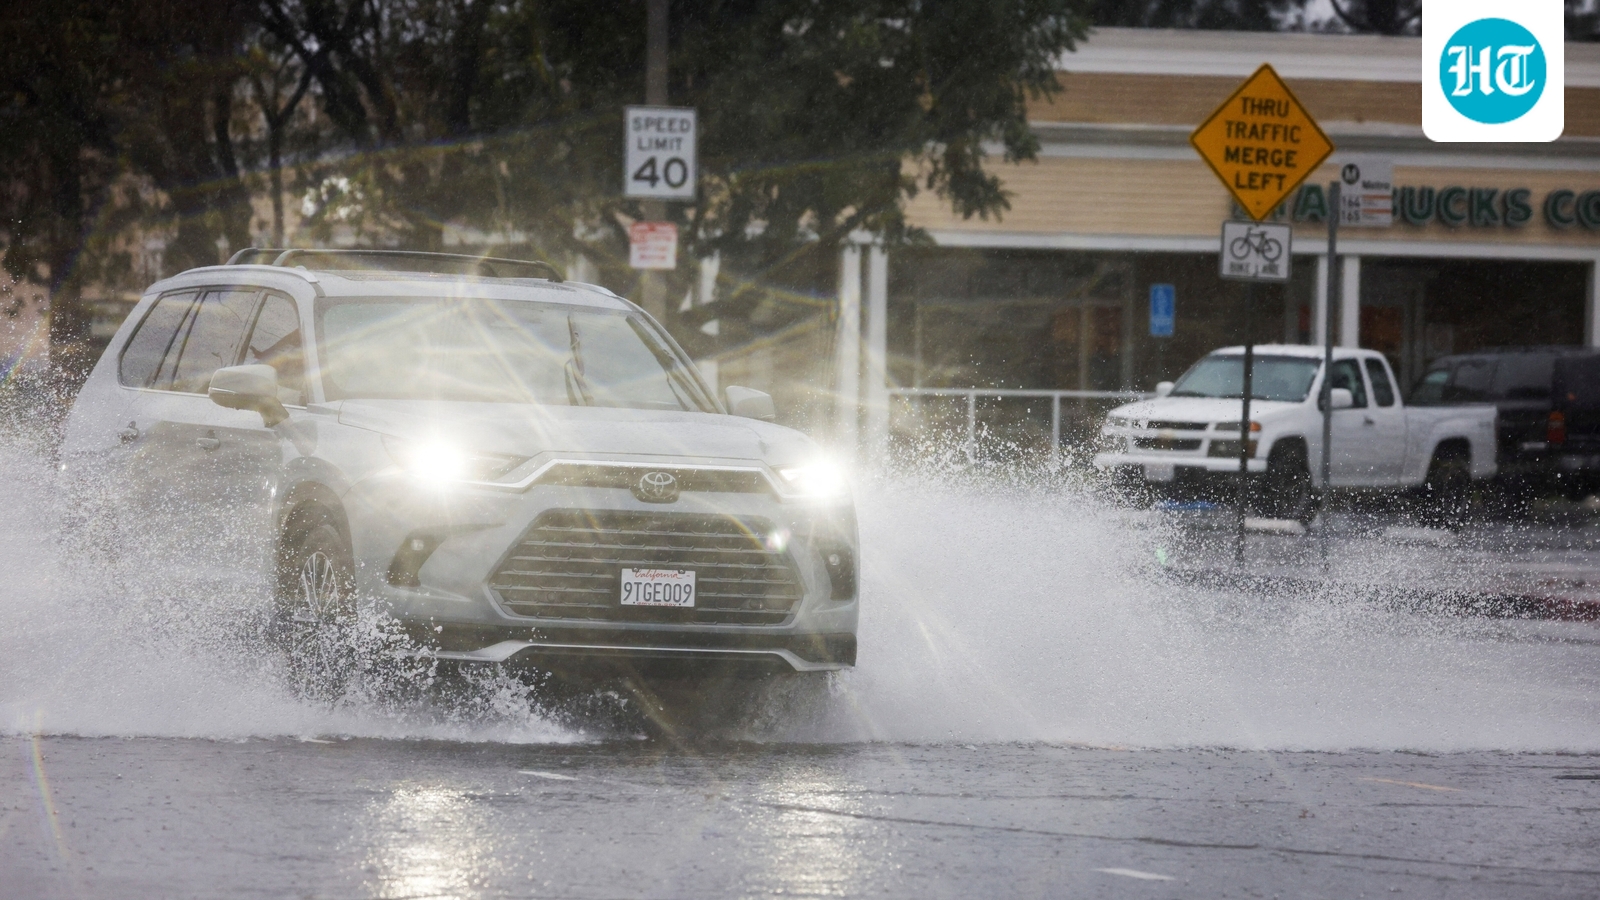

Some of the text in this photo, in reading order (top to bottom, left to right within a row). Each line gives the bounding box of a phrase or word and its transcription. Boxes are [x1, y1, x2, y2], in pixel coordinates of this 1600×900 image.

[1241, 97, 1290, 118] THRU
[632, 117, 691, 133] SPEED
[1225, 120, 1301, 144] TRAFFIC
[637, 137, 683, 151] LIMIT
[1224, 145, 1298, 168] MERGE
[633, 156, 688, 189] 40
[1234, 172, 1287, 191] LEFT
[634, 569, 682, 581] California
[623, 581, 692, 603] 9TGE009
